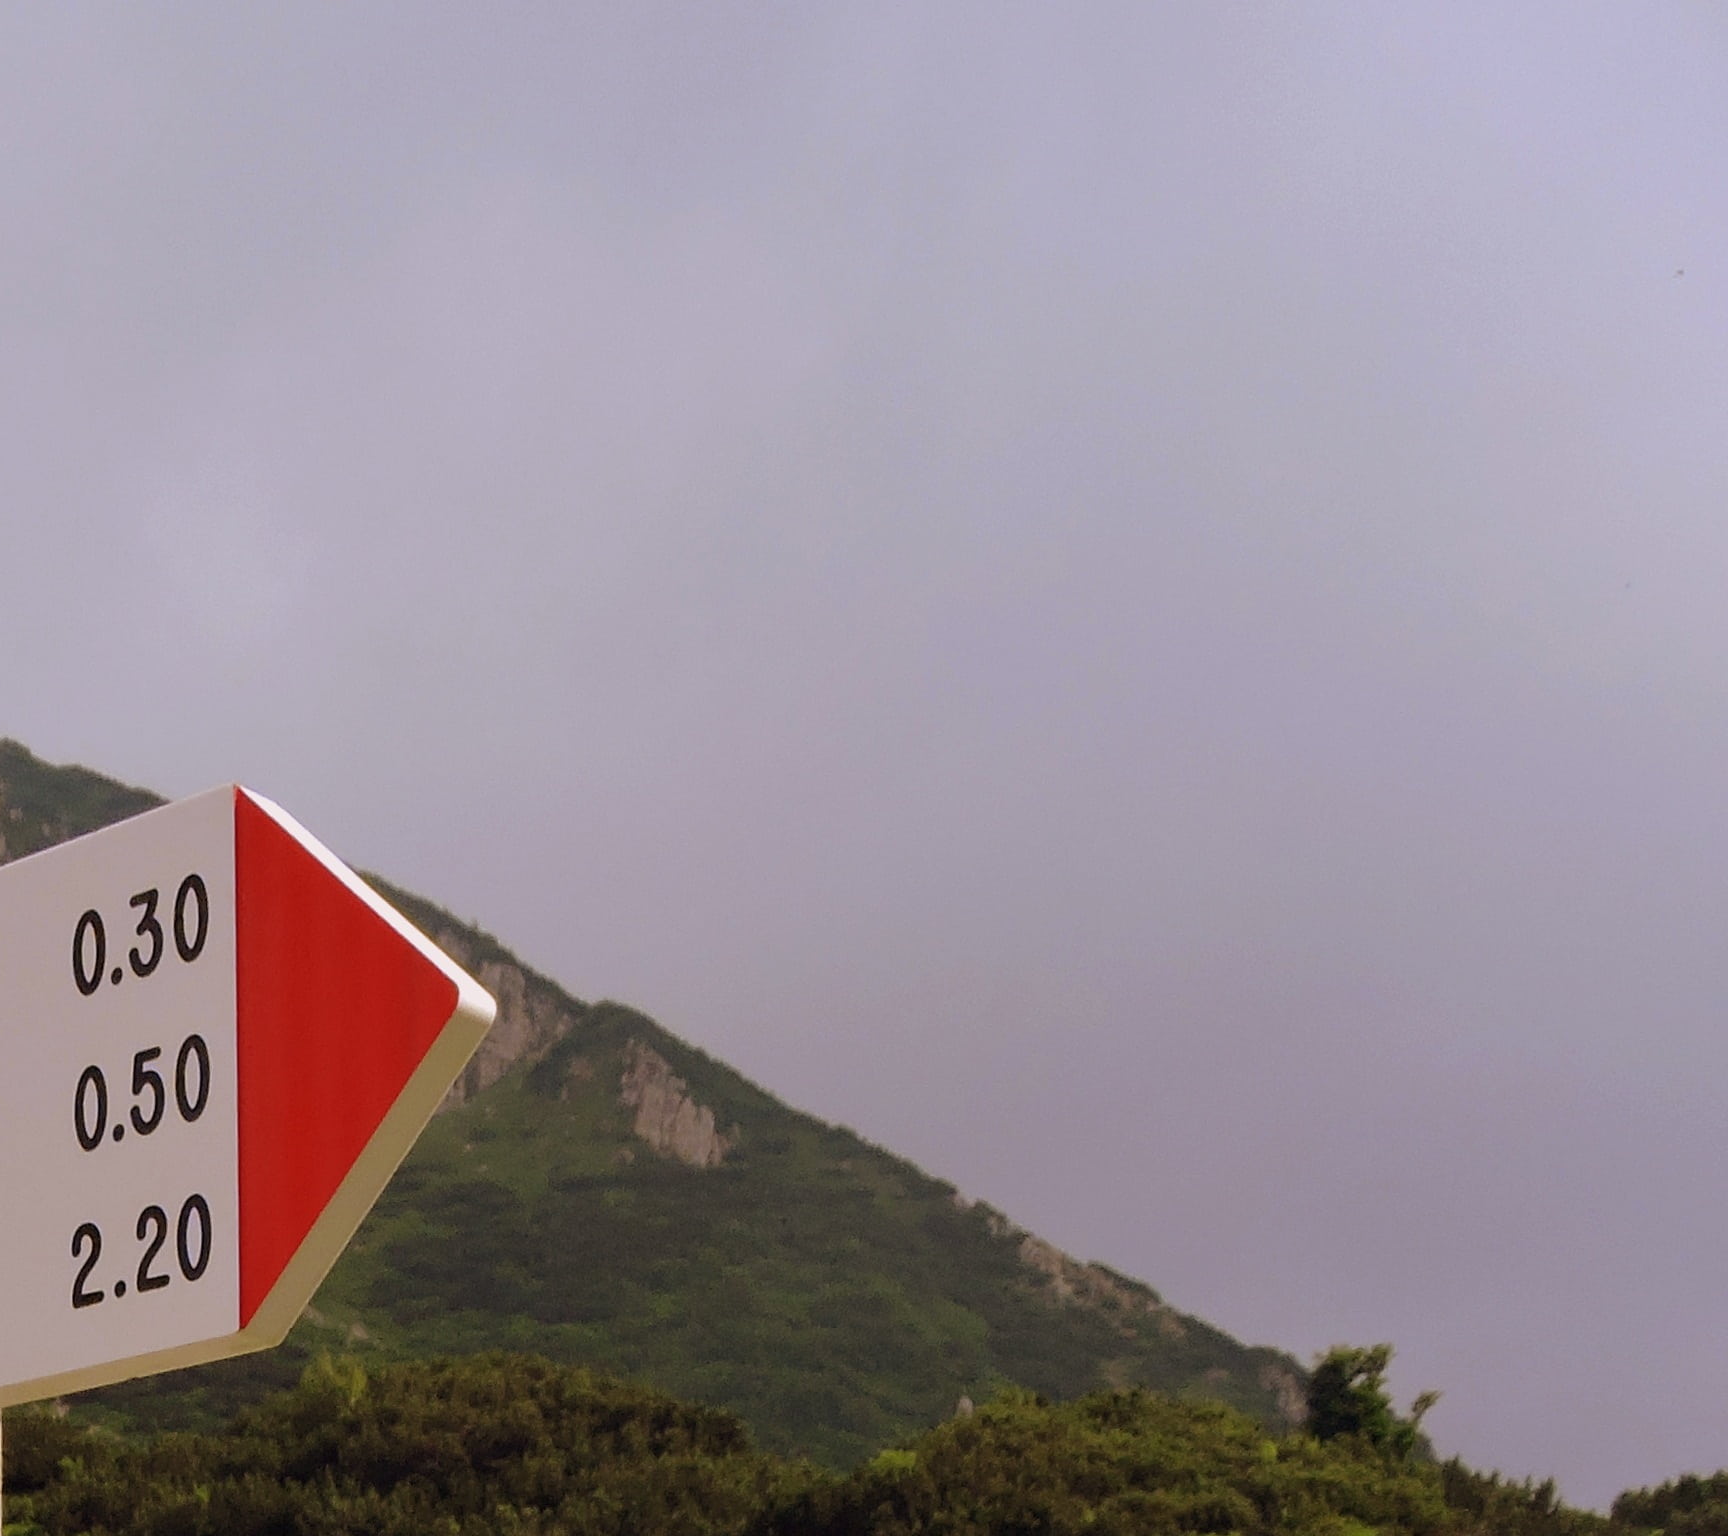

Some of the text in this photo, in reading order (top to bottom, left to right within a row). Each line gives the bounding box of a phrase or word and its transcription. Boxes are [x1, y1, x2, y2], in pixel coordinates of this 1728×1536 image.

[73, 874, 209, 996] 0.30
[74, 1034, 210, 1152] 0.50
[72, 1194, 212, 1309] 2.20
